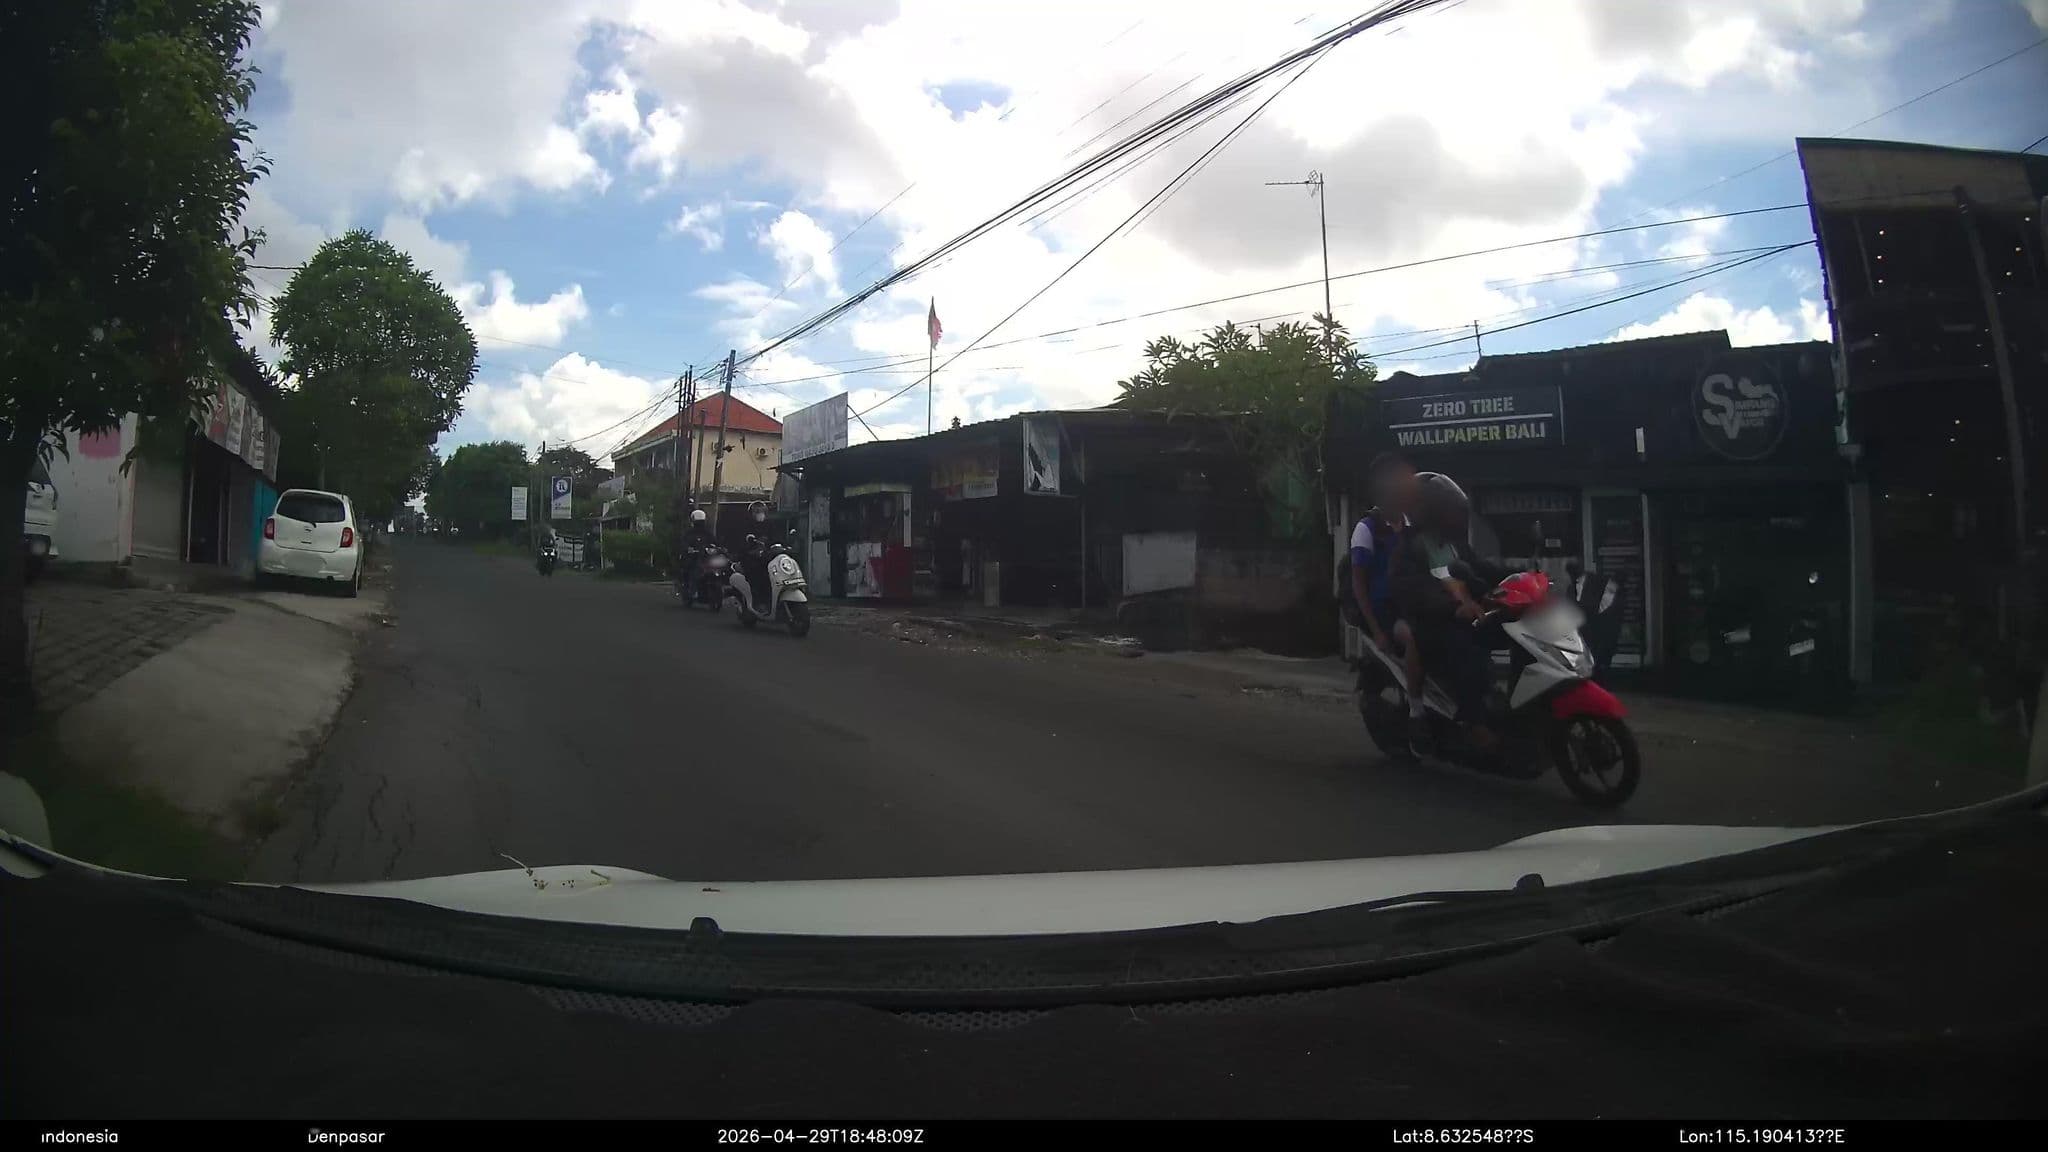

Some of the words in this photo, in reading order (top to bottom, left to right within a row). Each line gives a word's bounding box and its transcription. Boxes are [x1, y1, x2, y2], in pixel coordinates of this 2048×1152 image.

[1421, 400, 1466, 418] ZERO
[1470, 396, 1515, 415] TREE
[1397, 424, 1501, 447] WALLPAPER
[1504, 422, 1547, 440] BALI
